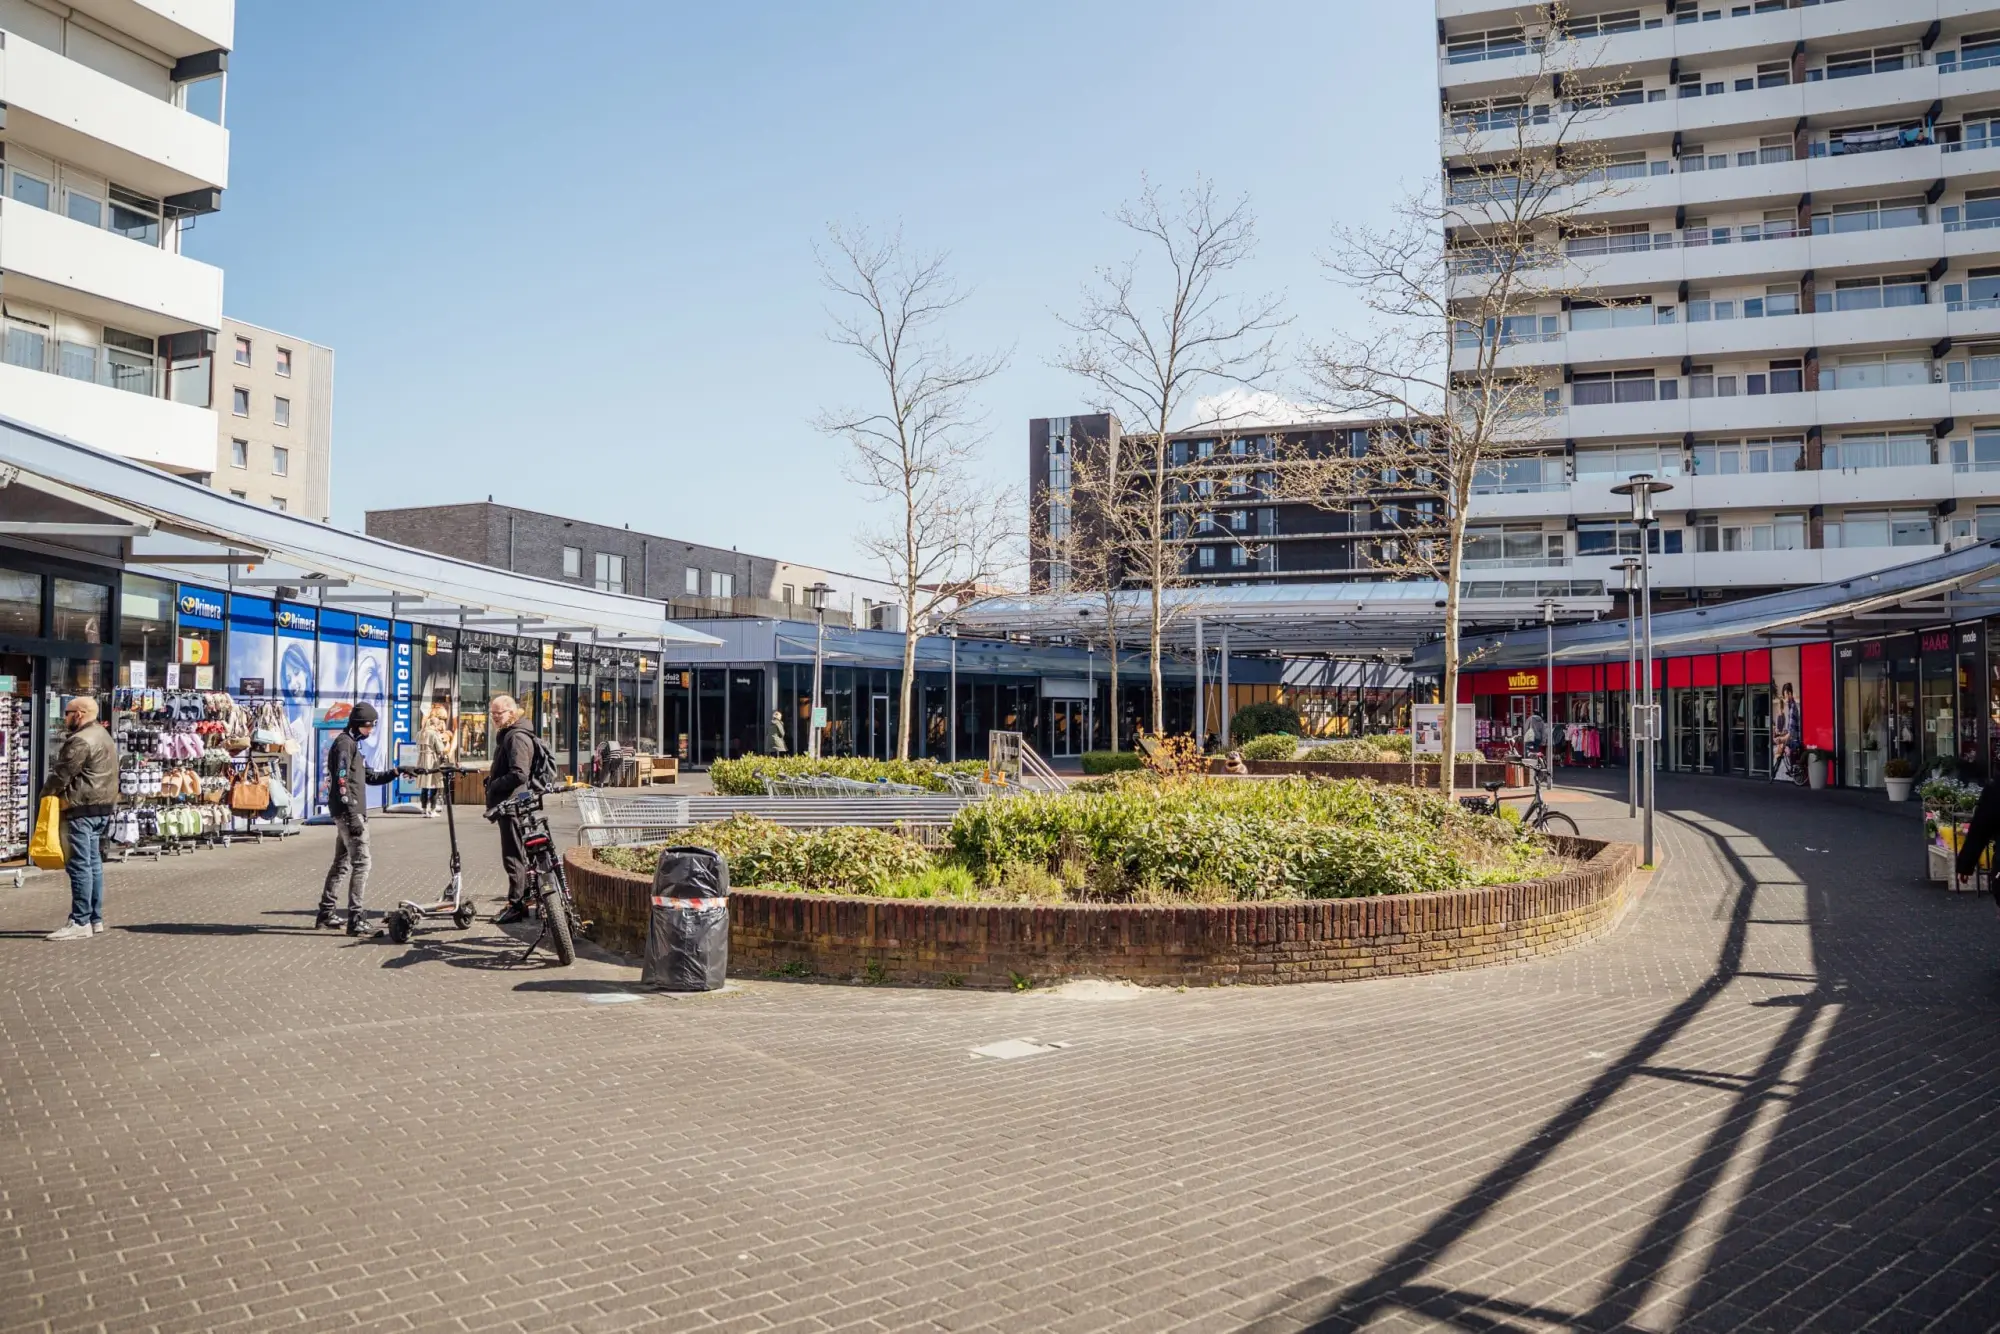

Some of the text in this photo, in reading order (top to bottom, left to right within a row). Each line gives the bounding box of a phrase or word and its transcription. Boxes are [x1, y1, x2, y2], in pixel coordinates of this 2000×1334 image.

[194, 598, 221, 620] Primera
[291, 614, 316, 632] Primera
[368, 626, 389, 641] Primera
[1840, 648, 1852, 658] salon
[1922, 632, 1950, 652] HAAR
[1962, 630, 1977, 644] mode
[553, 648, 573, 660] Sieben
[394, 643, 410, 733] Primera
[1508, 671, 1539, 687] wibra
